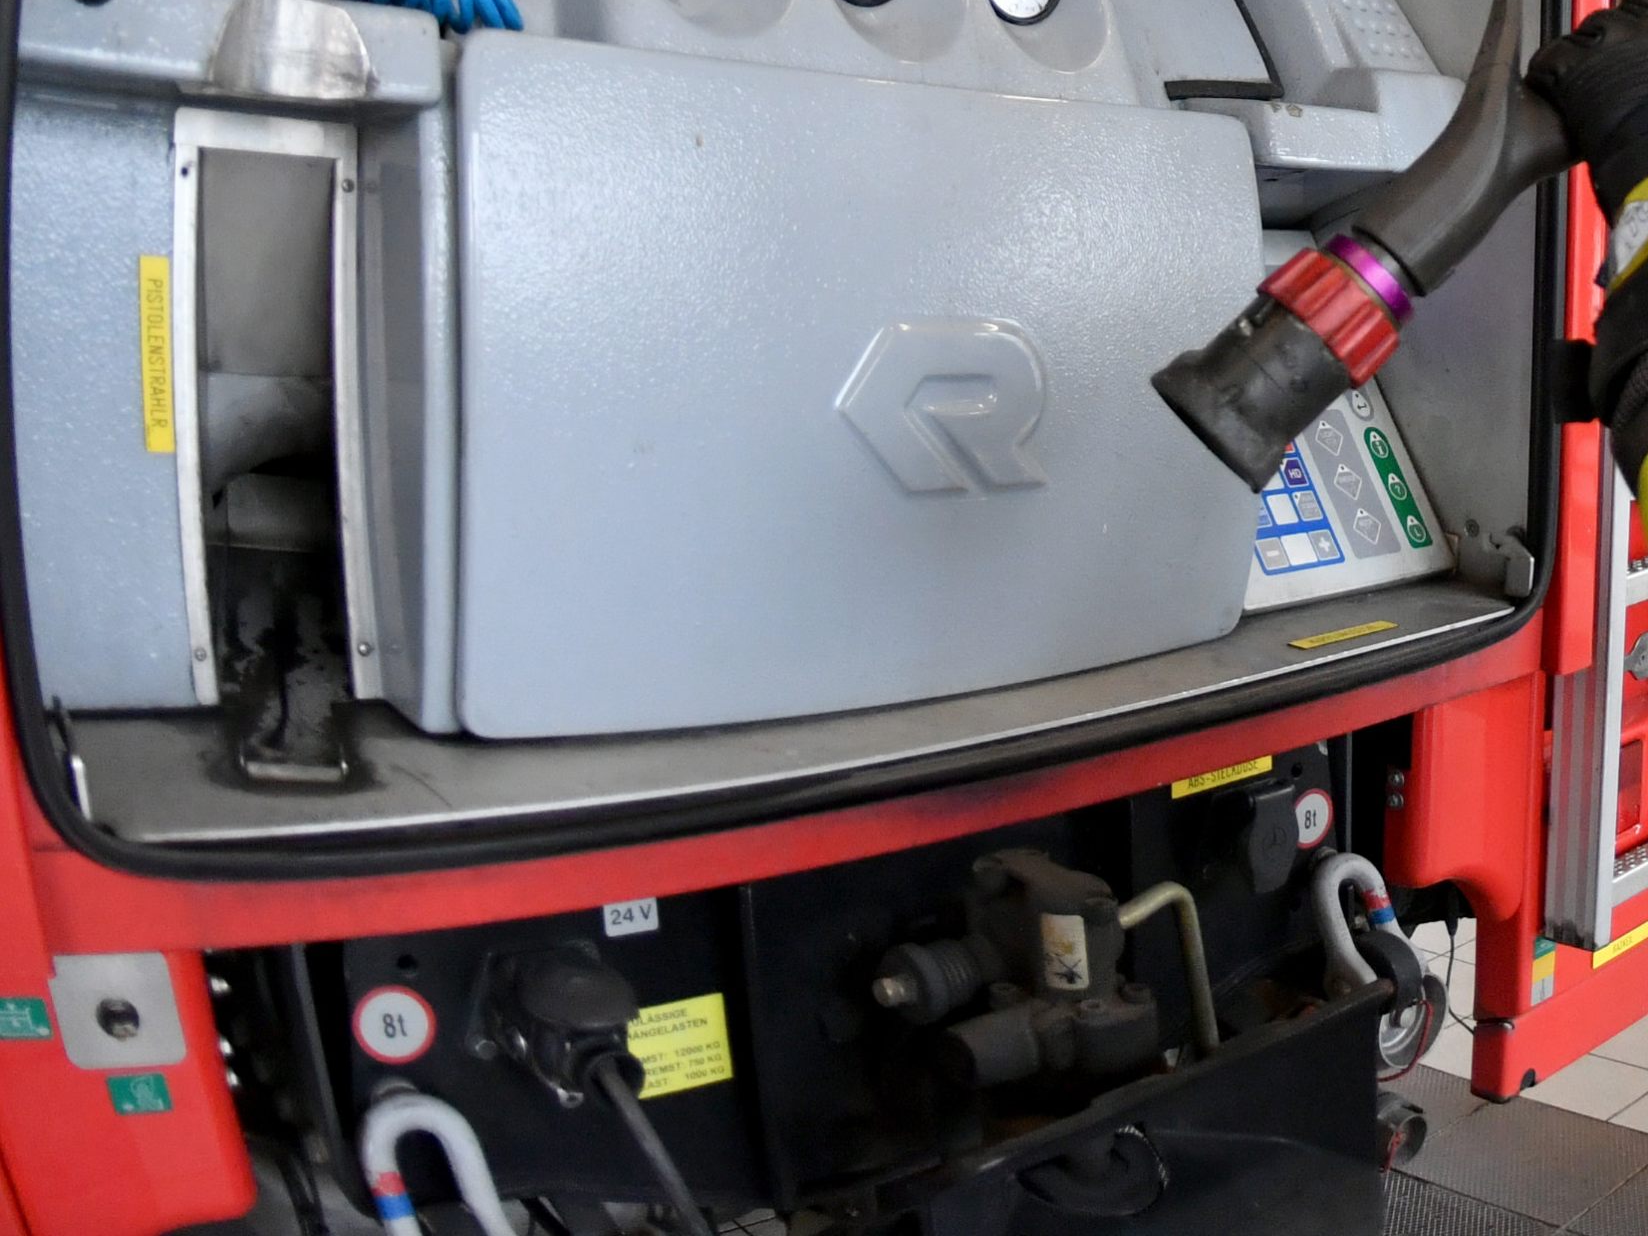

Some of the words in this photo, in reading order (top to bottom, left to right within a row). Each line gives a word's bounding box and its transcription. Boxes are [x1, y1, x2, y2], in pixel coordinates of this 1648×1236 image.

[1288, 468, 1302, 479] HD
[1304, 810, 1317, 830] 8t
[610, 906, 635, 926] 24
[638, 904, 652, 921] V
[381, 1012, 407, 1039] 8t
